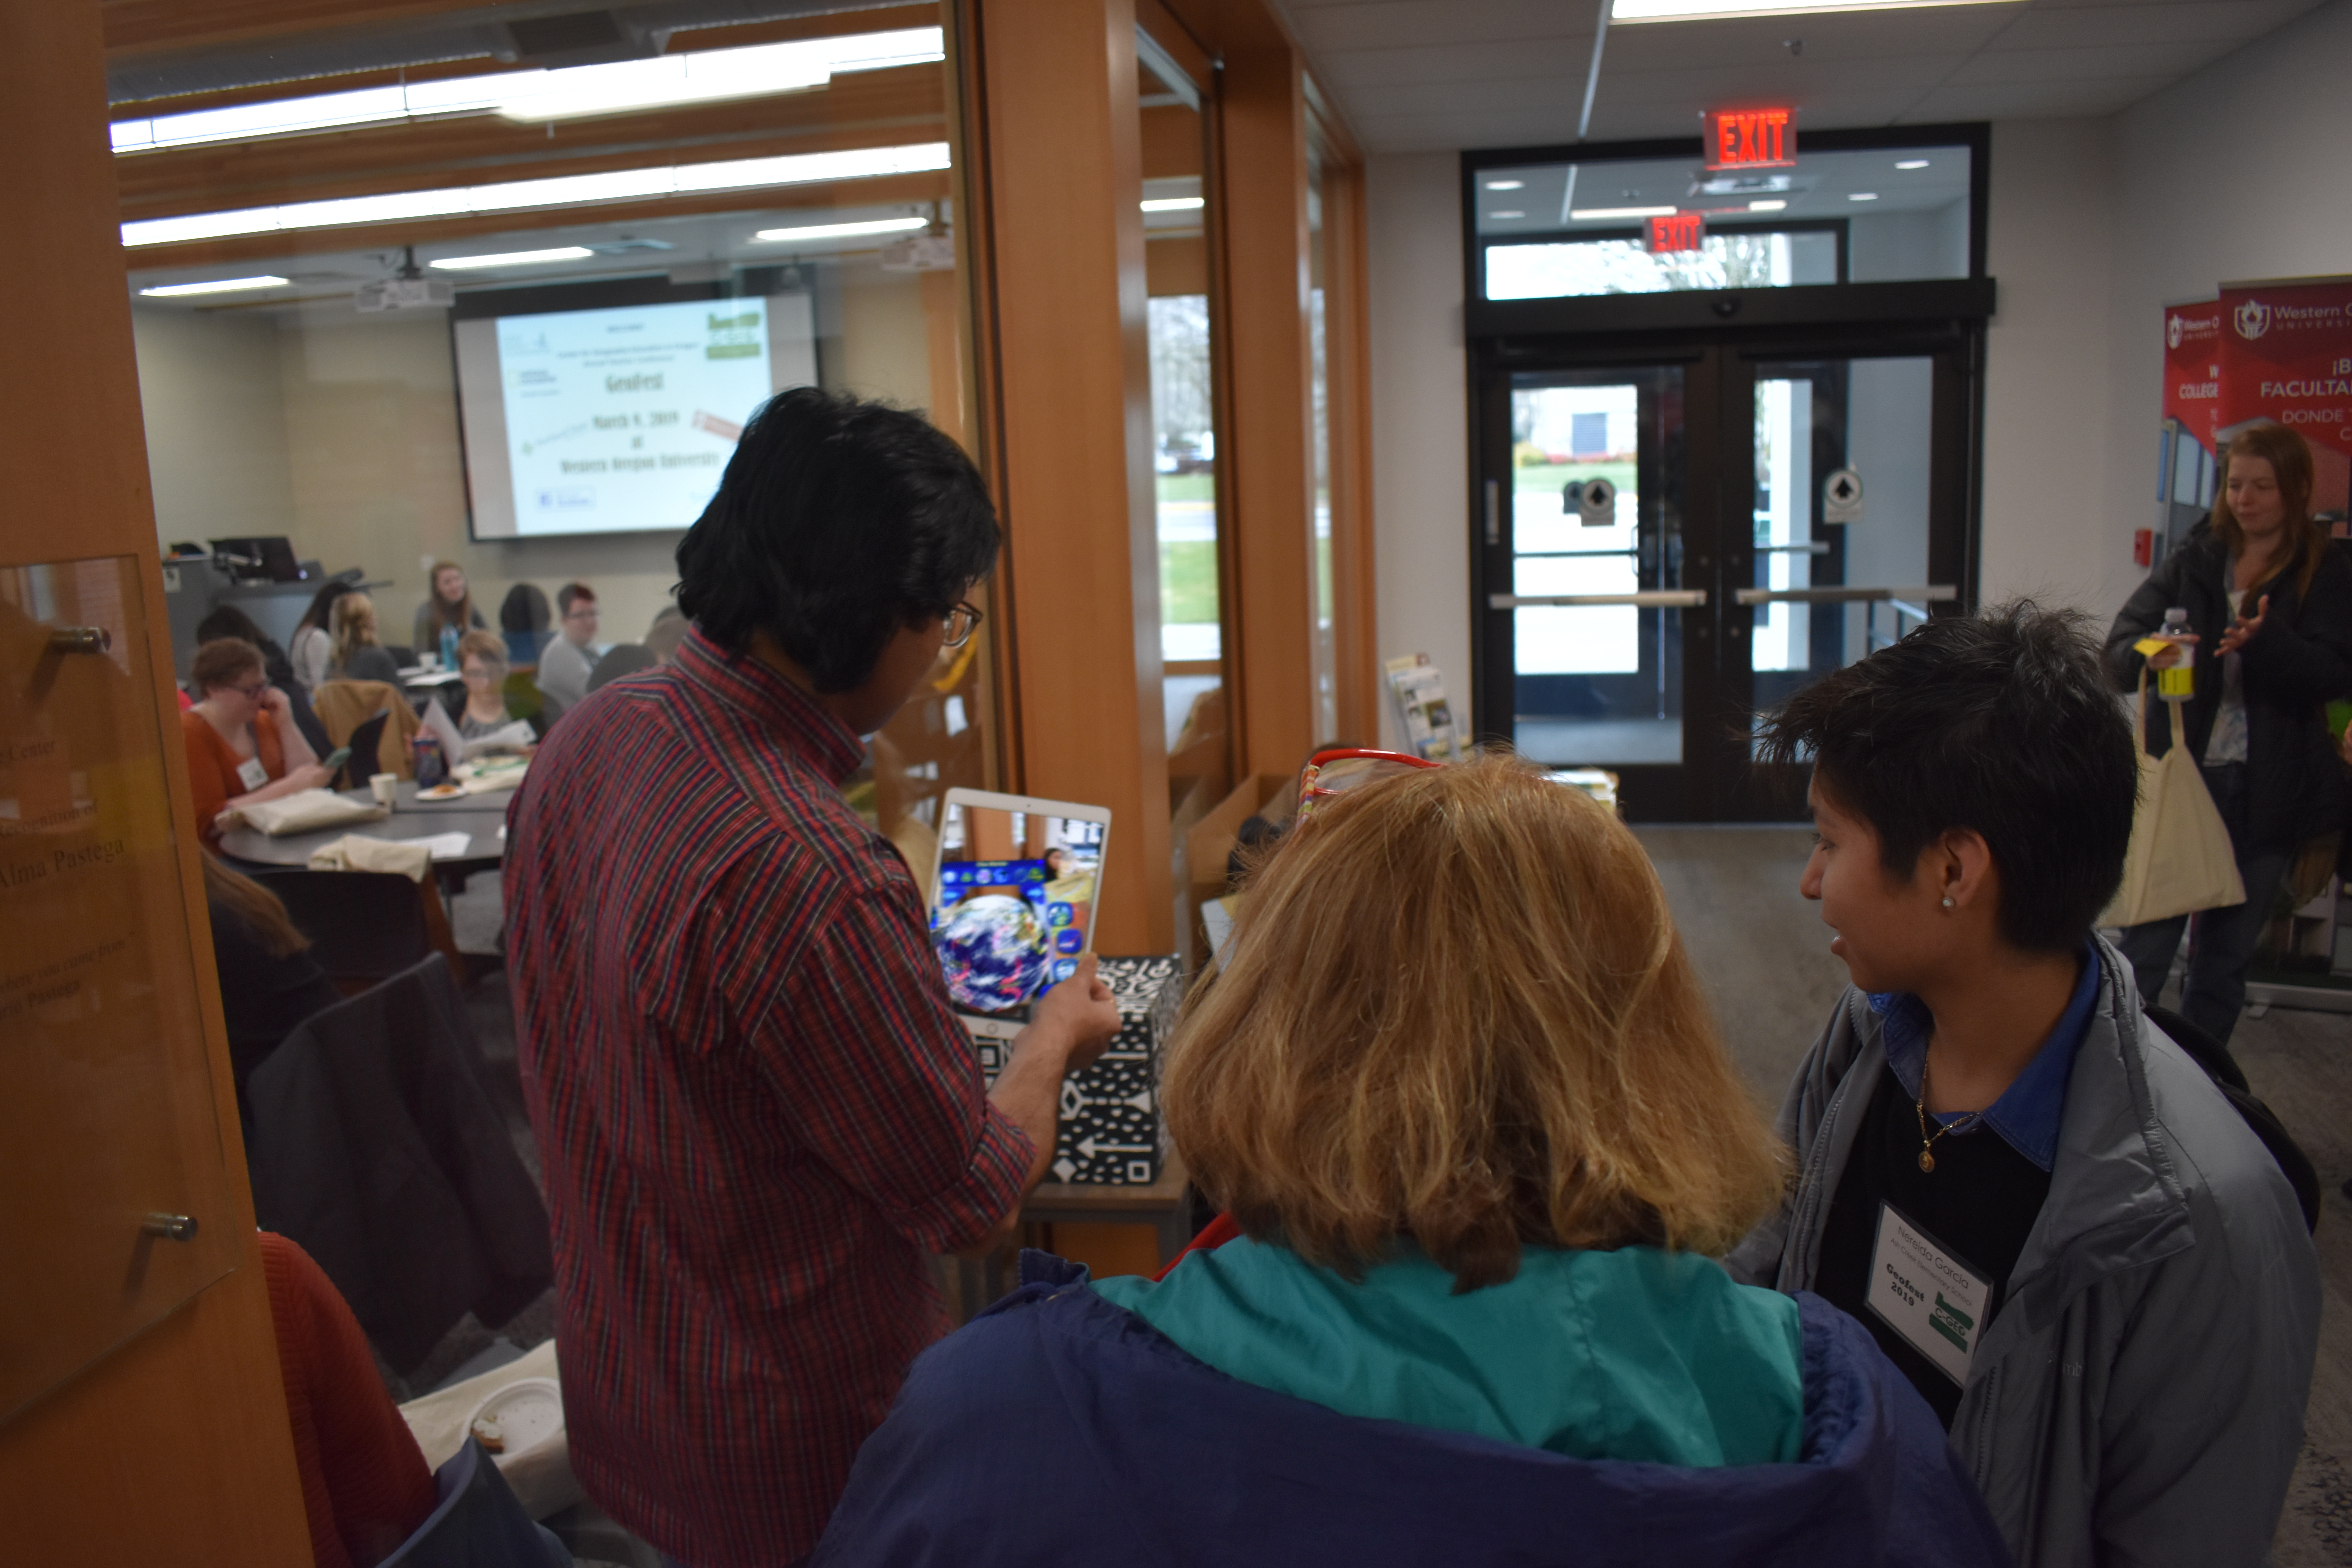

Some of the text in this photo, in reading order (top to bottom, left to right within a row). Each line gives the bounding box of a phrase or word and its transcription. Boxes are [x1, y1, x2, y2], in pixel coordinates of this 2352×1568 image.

[1718, 113, 1788, 163] EXIT
[1652, 216, 1700, 252] EXIT
[2274, 305, 2340, 320] Western
[2261, 379, 2352, 398] FACULTA
[2282, 408, 2344, 424] DONDE
[9, 740, 55, 760] Center
[53, 838, 125, 873] Pastega
[1898, 1226, 1933, 1262] Nereida
[1886, 1263, 1925, 1302] Geofest
[1890, 1281, 1915, 1307] 2019
